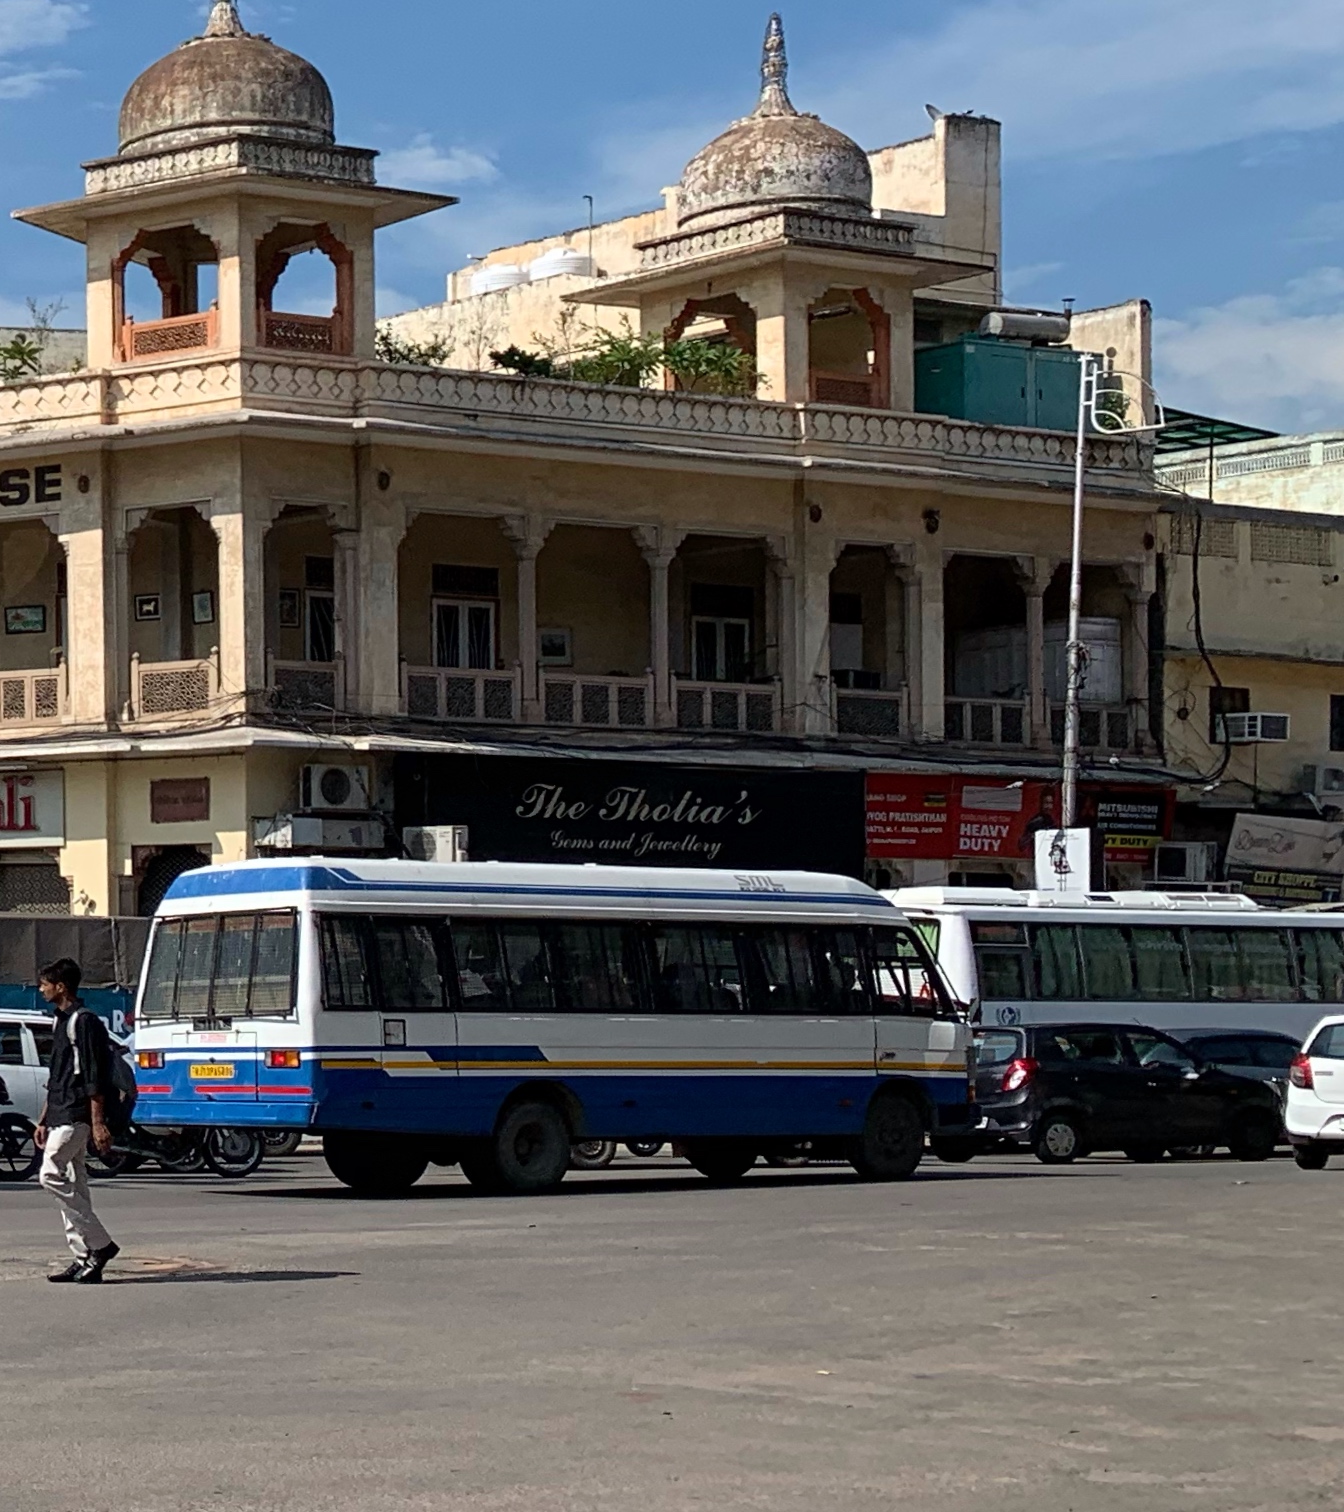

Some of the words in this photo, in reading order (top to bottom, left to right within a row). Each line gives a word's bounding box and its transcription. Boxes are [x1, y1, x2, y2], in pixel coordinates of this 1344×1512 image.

[515, 784, 594, 820] The
[599, 786, 763, 825] Tholia's
[959, 823, 1010, 838] HEAVY
[550, 830, 594, 849] Gems
[598, 832, 634, 850] and
[634, 831, 723, 860] Jewellery
[959, 837, 1002, 852] DUTY
